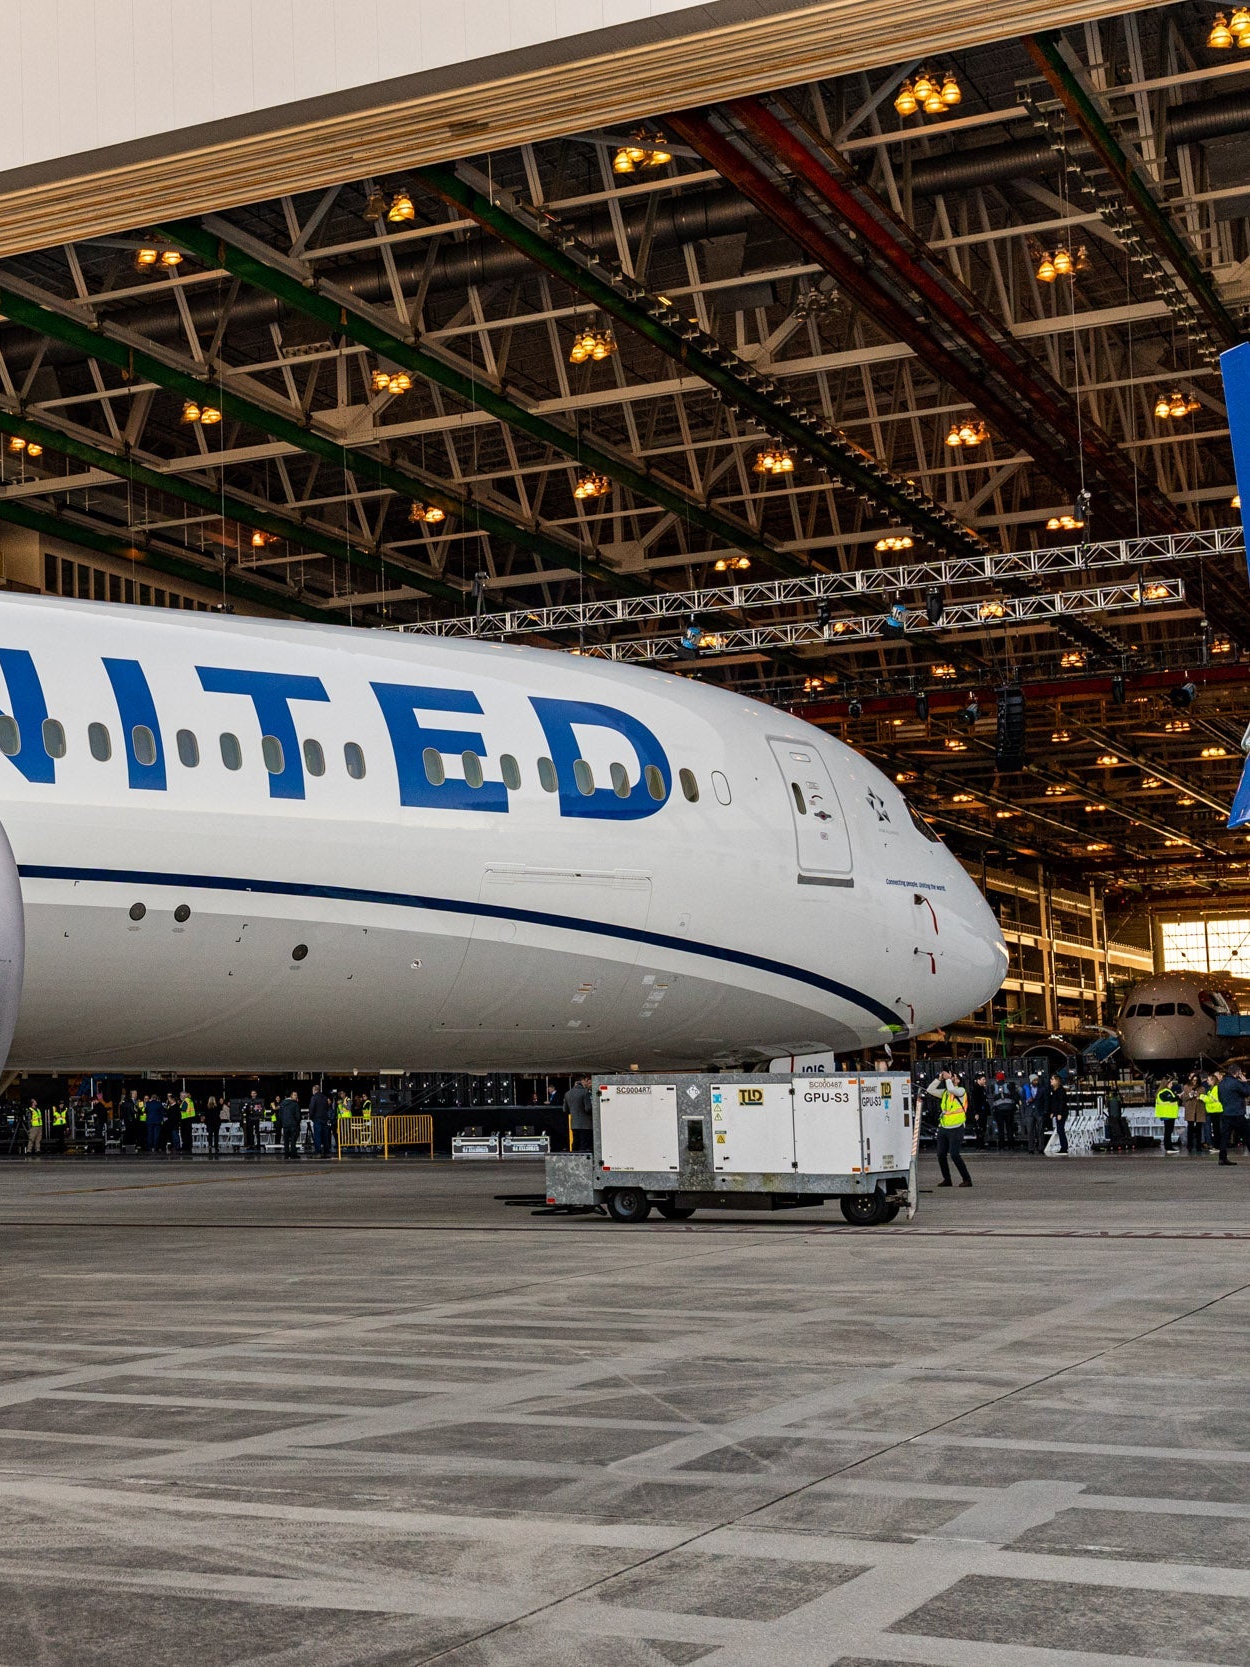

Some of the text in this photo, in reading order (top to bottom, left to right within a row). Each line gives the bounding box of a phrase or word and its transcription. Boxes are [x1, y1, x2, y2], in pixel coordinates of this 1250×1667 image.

[885, 878, 906, 887] Connecting
[616, 1086, 651, 1094] SC000487
[809, 1081, 842, 1089] SC000487
[881, 1082, 892, 1097] TLD
[739, 1089, 763, 1102] TLD
[804, 1092, 850, 1103] GPU-S3
[862, 1097, 882, 1107] GPU-S3
